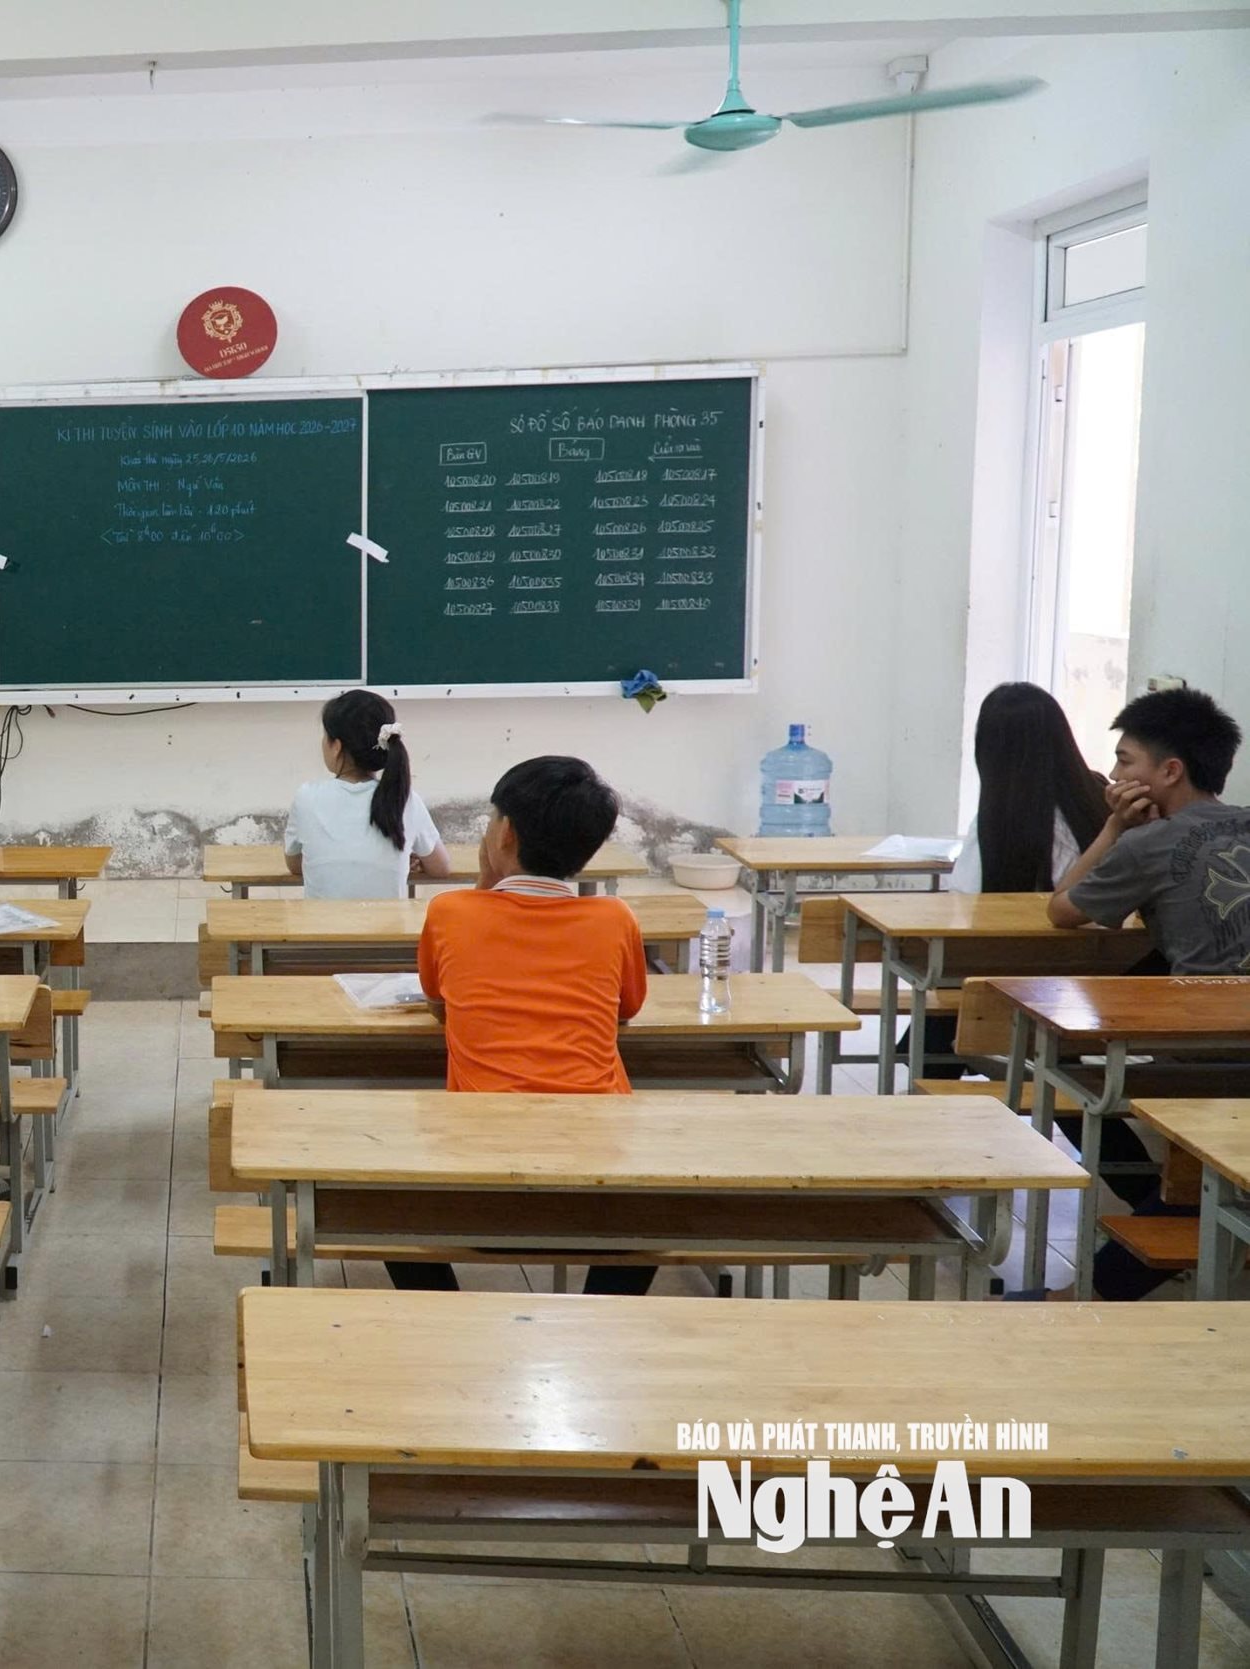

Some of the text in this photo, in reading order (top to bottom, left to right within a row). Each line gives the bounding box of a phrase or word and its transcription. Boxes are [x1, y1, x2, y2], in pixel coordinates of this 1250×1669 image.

[74, 427, 95, 441] THI
[178, 419, 203, 438] VÀO
[207, 415, 229, 438] LỚP
[232, 423, 245, 437] 10
[610, 414, 645, 429] DANH
[654, 407, 697, 428] PHÒNG
[700, 410, 724, 425] 35
